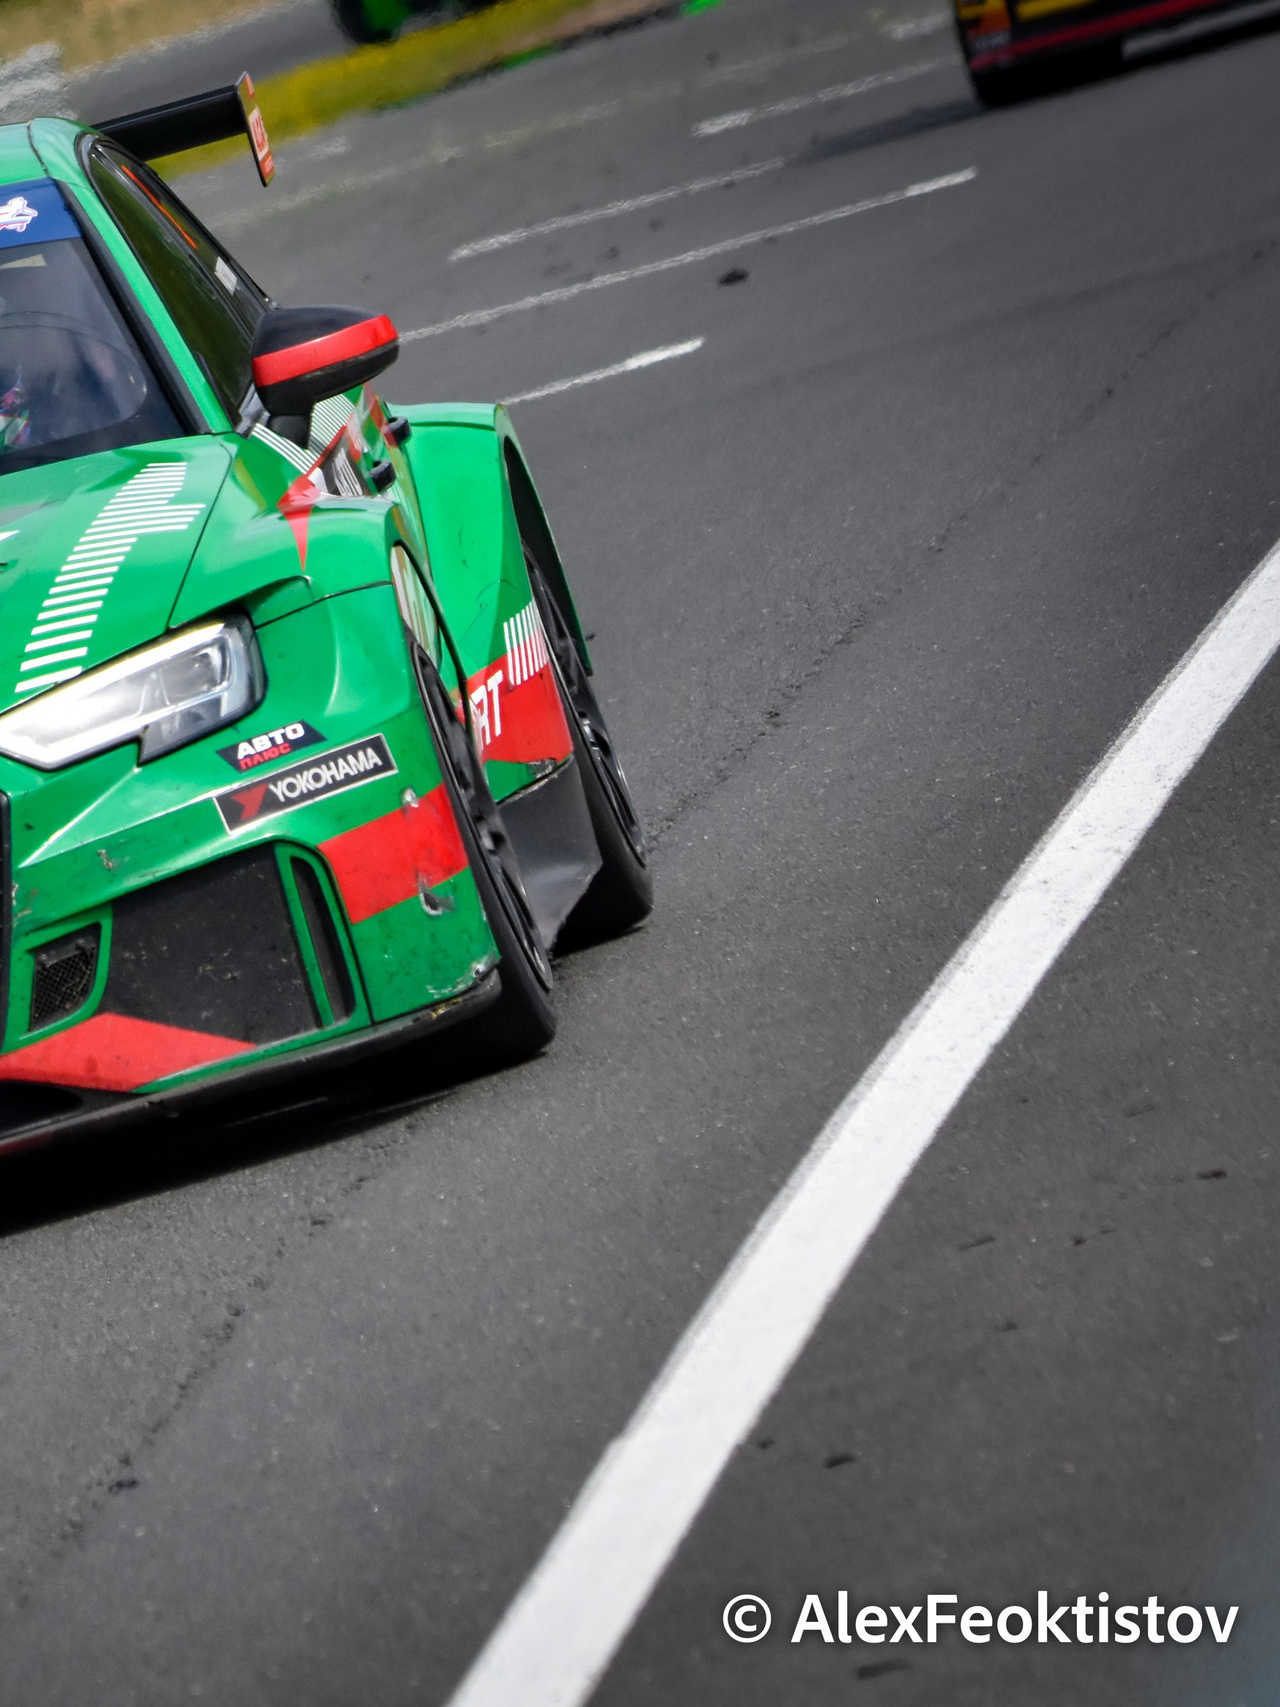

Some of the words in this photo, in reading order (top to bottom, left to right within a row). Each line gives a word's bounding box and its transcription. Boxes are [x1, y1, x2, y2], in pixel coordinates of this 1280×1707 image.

[237, 722, 305, 760] АВТО
[239, 742, 293, 771] ПЛЮС
[269, 747, 383, 802] YOKOHAMA
